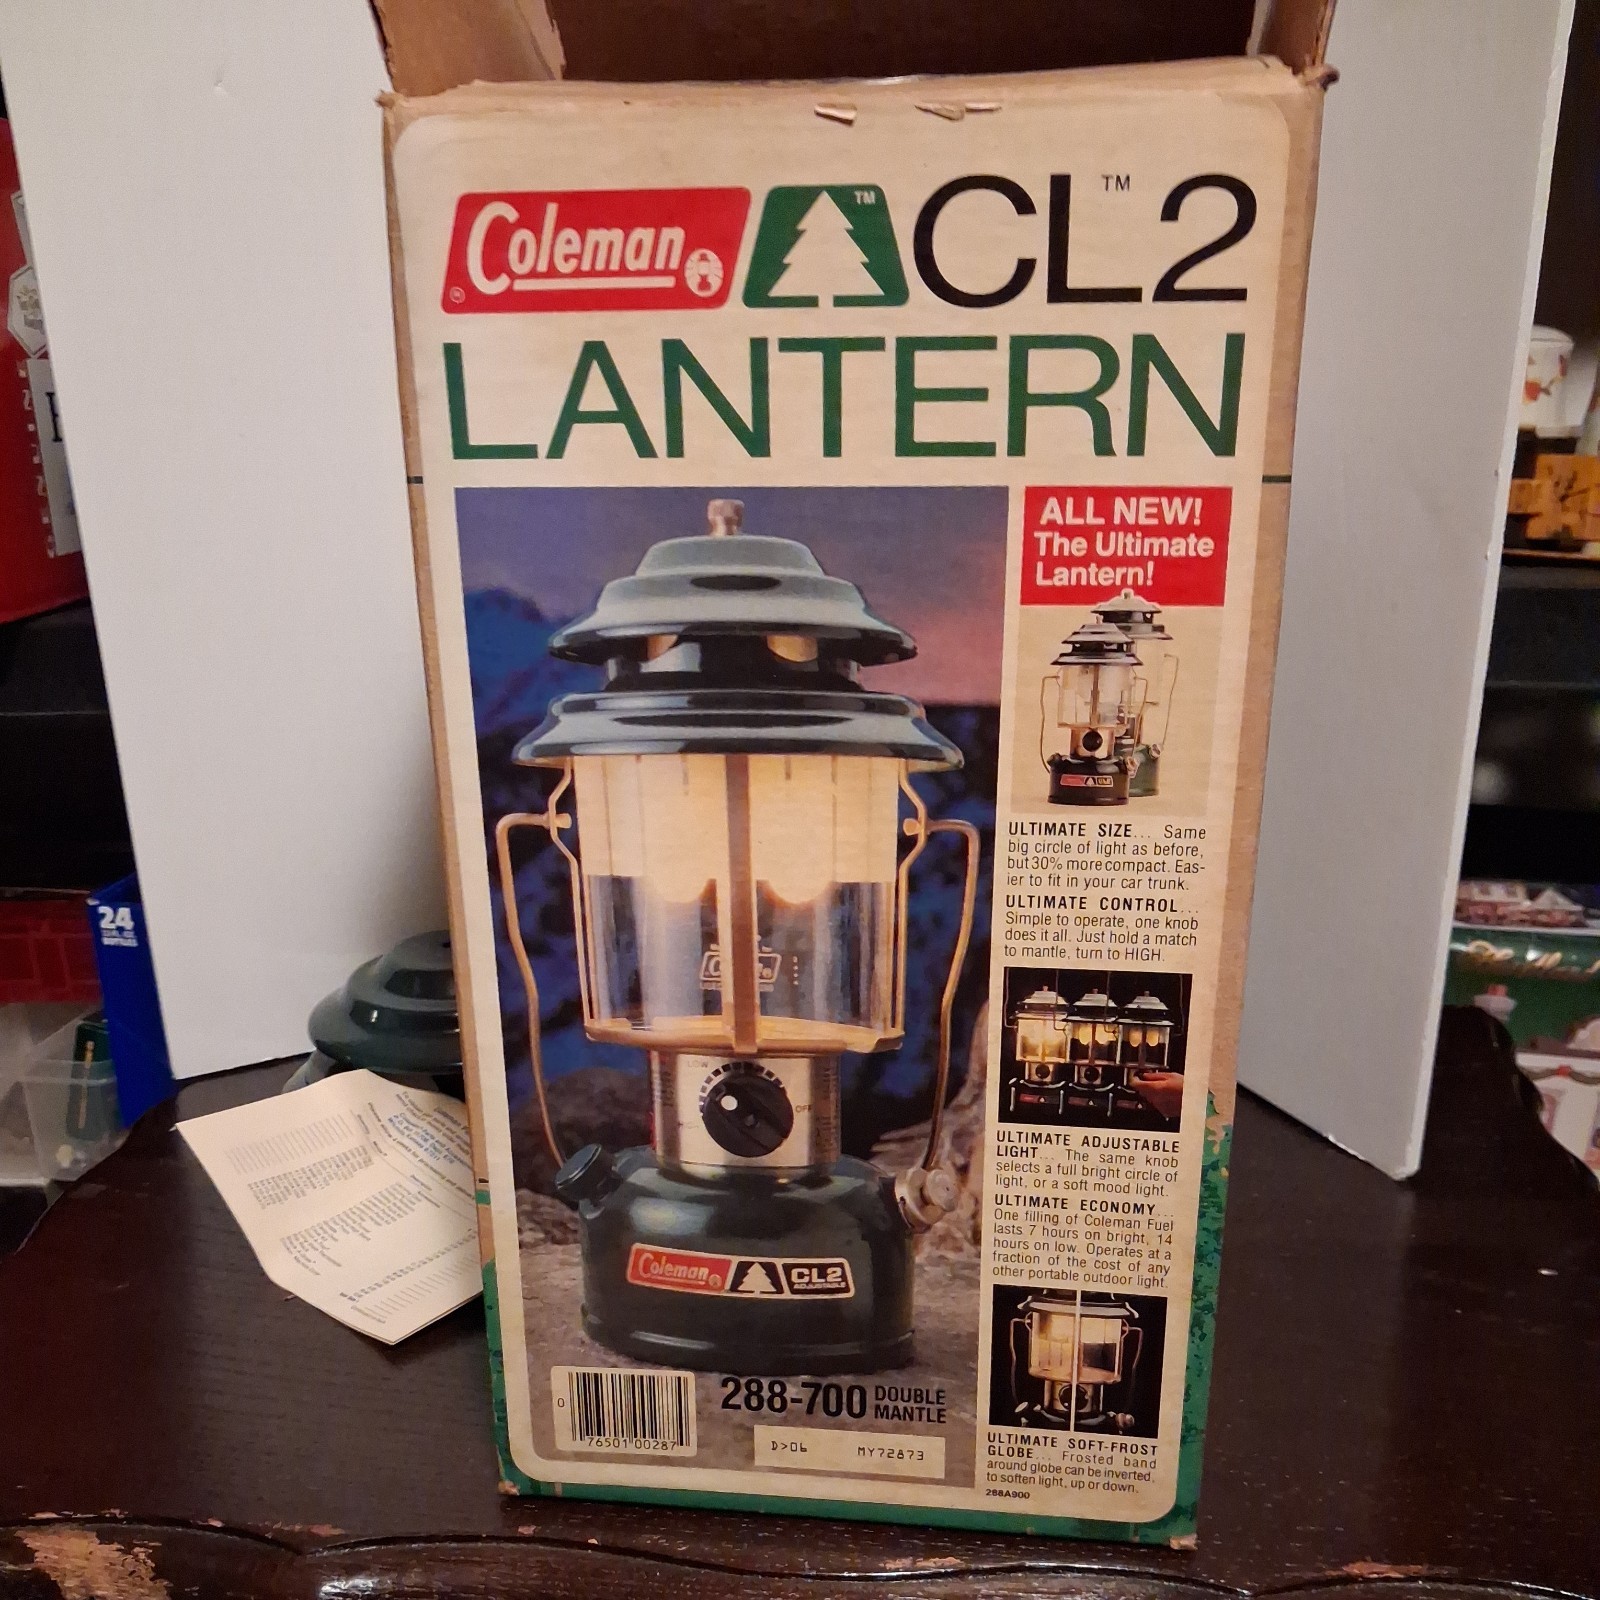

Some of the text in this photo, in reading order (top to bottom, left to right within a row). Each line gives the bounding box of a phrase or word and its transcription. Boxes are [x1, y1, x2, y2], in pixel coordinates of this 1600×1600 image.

[1101, 176, 1130, 191] TM
[467, 200, 686, 295] Coleman
[913, 174, 1257, 309] CL2
[442, 331, 1245, 460] LANTERN
[1040, 497, 1203, 526] ALL NEW!
[1034, 531, 1214, 558] The Ultimate
[1036, 561, 1154, 586] Lantern!
[1008, 822, 1086, 837] ULTIMATE
[1164, 825, 1206, 839] Same
[1009, 840, 1203, 859] big circle of light as before,
[1007, 856, 1205, 875] but 30% more compact. Eas-
[1007, 873, 1189, 891] ier to fit in your car trunk.
[1005, 895, 1087, 910] ULTIMATE
[98, 906, 135, 930] 24
[1005, 912, 1198, 930] Simple to operate, one knob
[1005, 929, 1197, 946] does it all. Just hold a match
[1004, 945, 1165, 962] to mantle, turn to HIGH.
[997, 1130, 1180, 1153] ULTIMATE ADJUSTABLE
[1066, 1149, 1089, 1161] The
[1099, 1153, 1135, 1165] same
[1145, 1156, 1179, 1168] knob
[996, 1161, 1178, 1182] selects a full bright circle of
[995, 1174, 1169, 1197] light, or a soft mood light.
[995, 1194, 1068, 1209] ULTIMATE
[994, 1209, 1174, 1231] One filling of Coleman Fuel
[994, 1223, 1172, 1245] lasts 7 hours on bright, 14
[993, 1237, 1171, 1260] hours on low. Operates at a
[639, 1253, 709, 1283] Coleman
[993, 1252, 1171, 1277] fraction of the cost of any
[791, 1267, 842, 1283] CL2
[993, 1266, 1168, 1288] other portable outdoor light.
[558, 1398, 565, 1408] 0
[721, 1377, 945, 1419] 288-700 DOUBLE
[874, 1406, 947, 1424] MANTLE
[587, 1436, 677, 1451] 76501 00287
[858, 1446, 924, 1460] MY72873
[988, 1432, 1158, 1456] ULTIMATE SOFT-FROST
[987, 1460, 1027, 1472] around
[1031, 1462, 1061, 1474] globe
[1065, 1466, 1084, 1476] can
[1088, 1467, 1101, 1477] be
[1062, 1451, 1113, 1465] Frosted
[1123, 1456, 1157, 1469] band
[987, 1472, 998, 1482] to
[1001, 1474, 1035, 1485] soften
[1070, 1479, 1085, 1490] up
[1088, 1482, 1100, 1490] or
